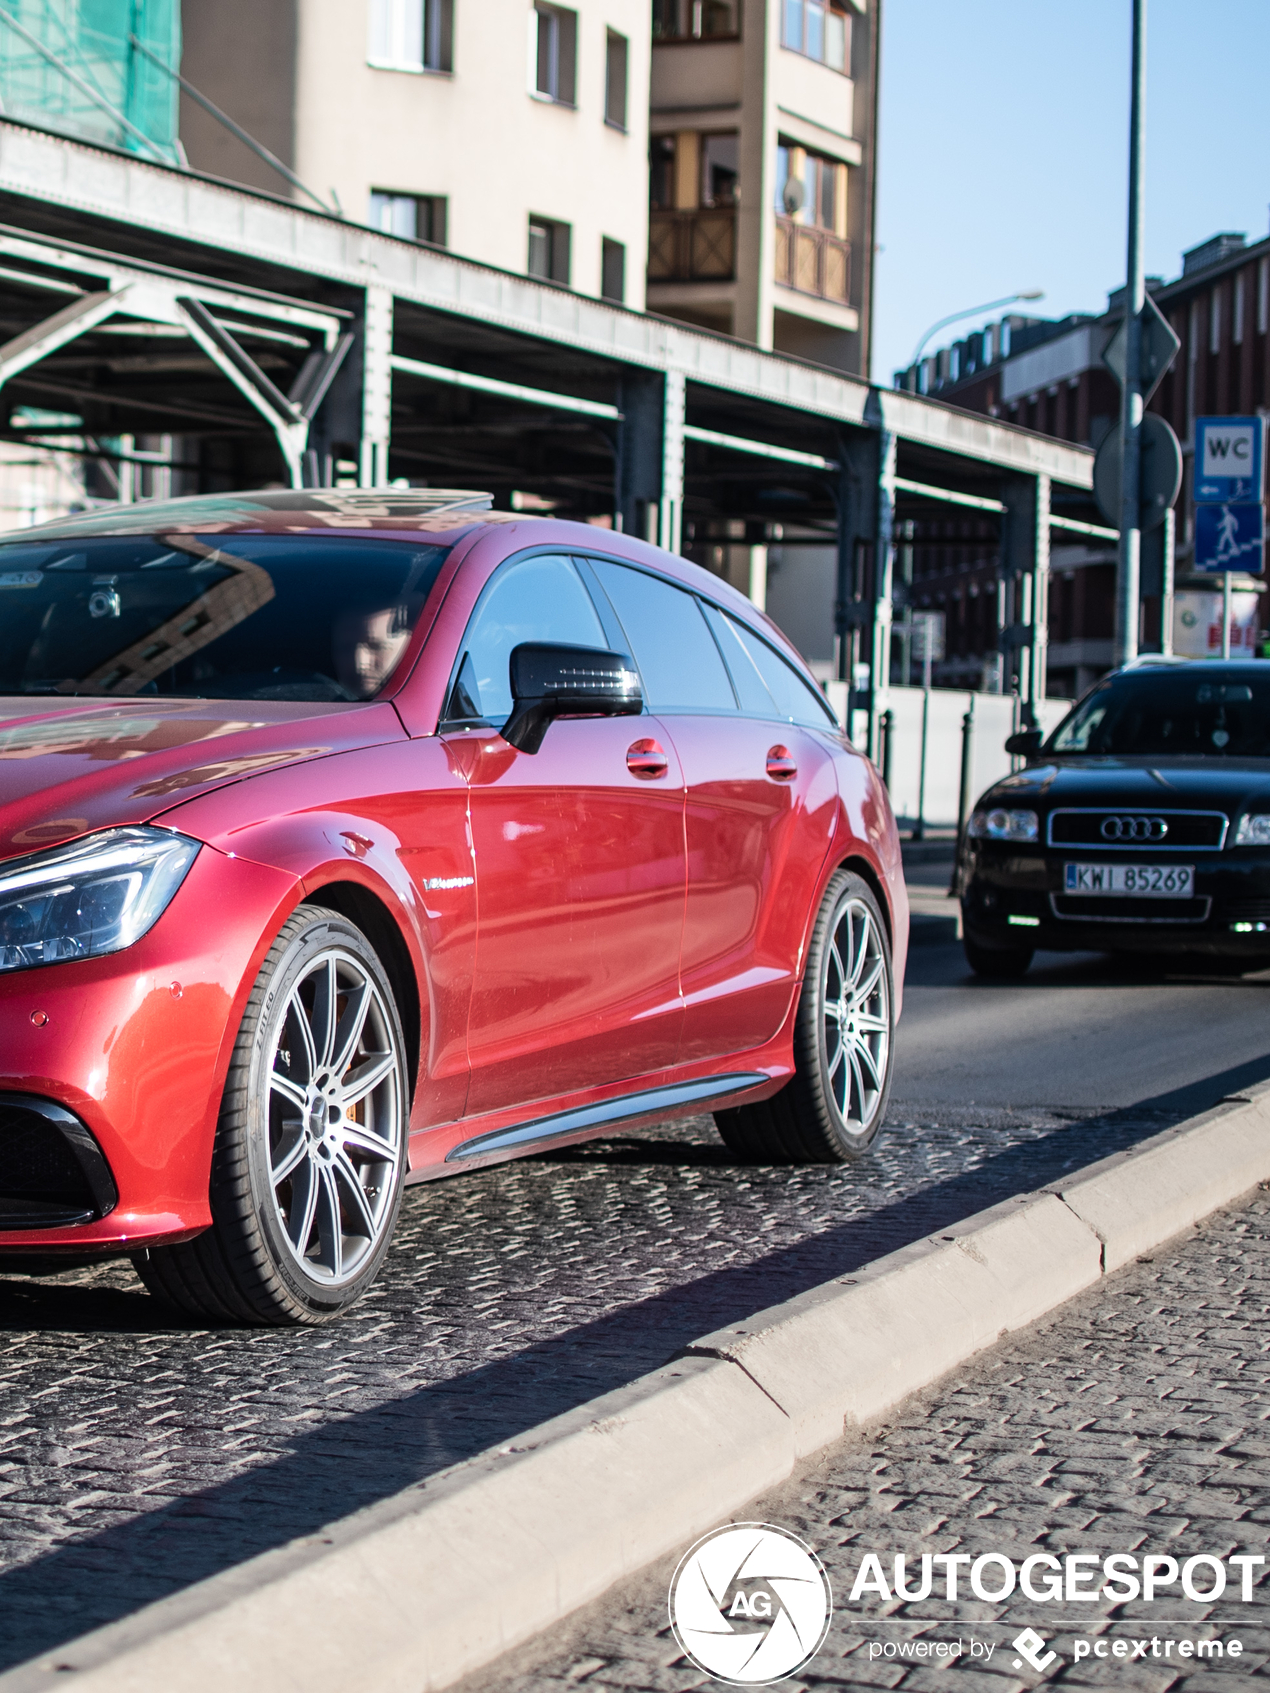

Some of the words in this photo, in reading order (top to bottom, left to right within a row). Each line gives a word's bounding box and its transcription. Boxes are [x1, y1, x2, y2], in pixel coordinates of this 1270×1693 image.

[1207, 436, 1250, 460] WC
[1077, 867, 1114, 890] KWI
[1124, 867, 1190, 891] 85269
